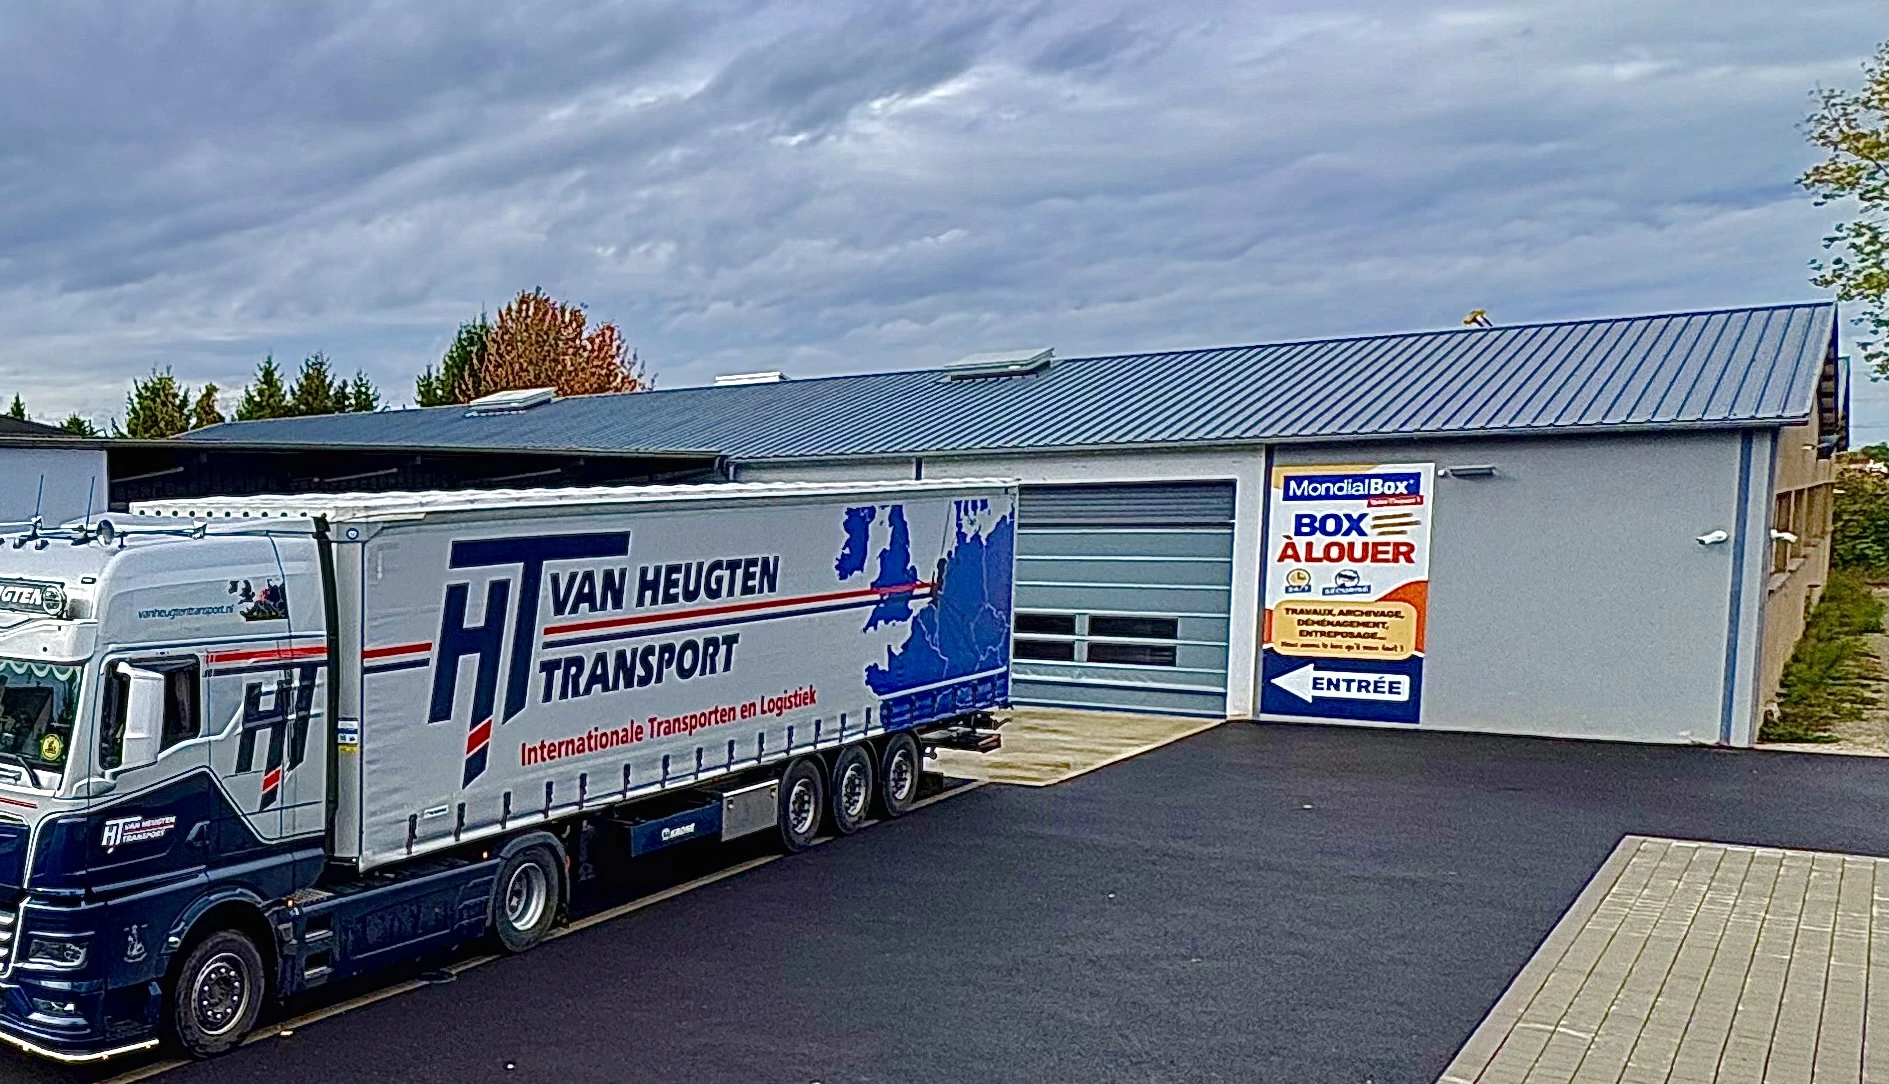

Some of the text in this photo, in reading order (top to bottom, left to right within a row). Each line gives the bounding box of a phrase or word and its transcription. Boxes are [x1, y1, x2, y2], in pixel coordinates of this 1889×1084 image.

[1289, 479, 1408, 496] MondialBox
[1294, 513, 1369, 537] BOX
[1277, 535, 1415, 563] À LOUER
[550, 556, 779, 617] VAN HEUGTEN
[138, 604, 234, 619] vanheugtentransport.nl
[1284, 608, 1405, 619] TRAVAUX, ARCHIVAGE,
[1297, 619, 1389, 630] DÉMÉNAGEMENT,
[427, 531, 630, 789] HT
[539, 633, 740, 703] TRANSPORT
[1312, 677, 1402, 695] ENTRÉE
[521, 685, 816, 766] Internationale Transporten en Logistiek
[125, 822, 140, 830] VAN
[123, 829, 165, 843] TRANSPORT
